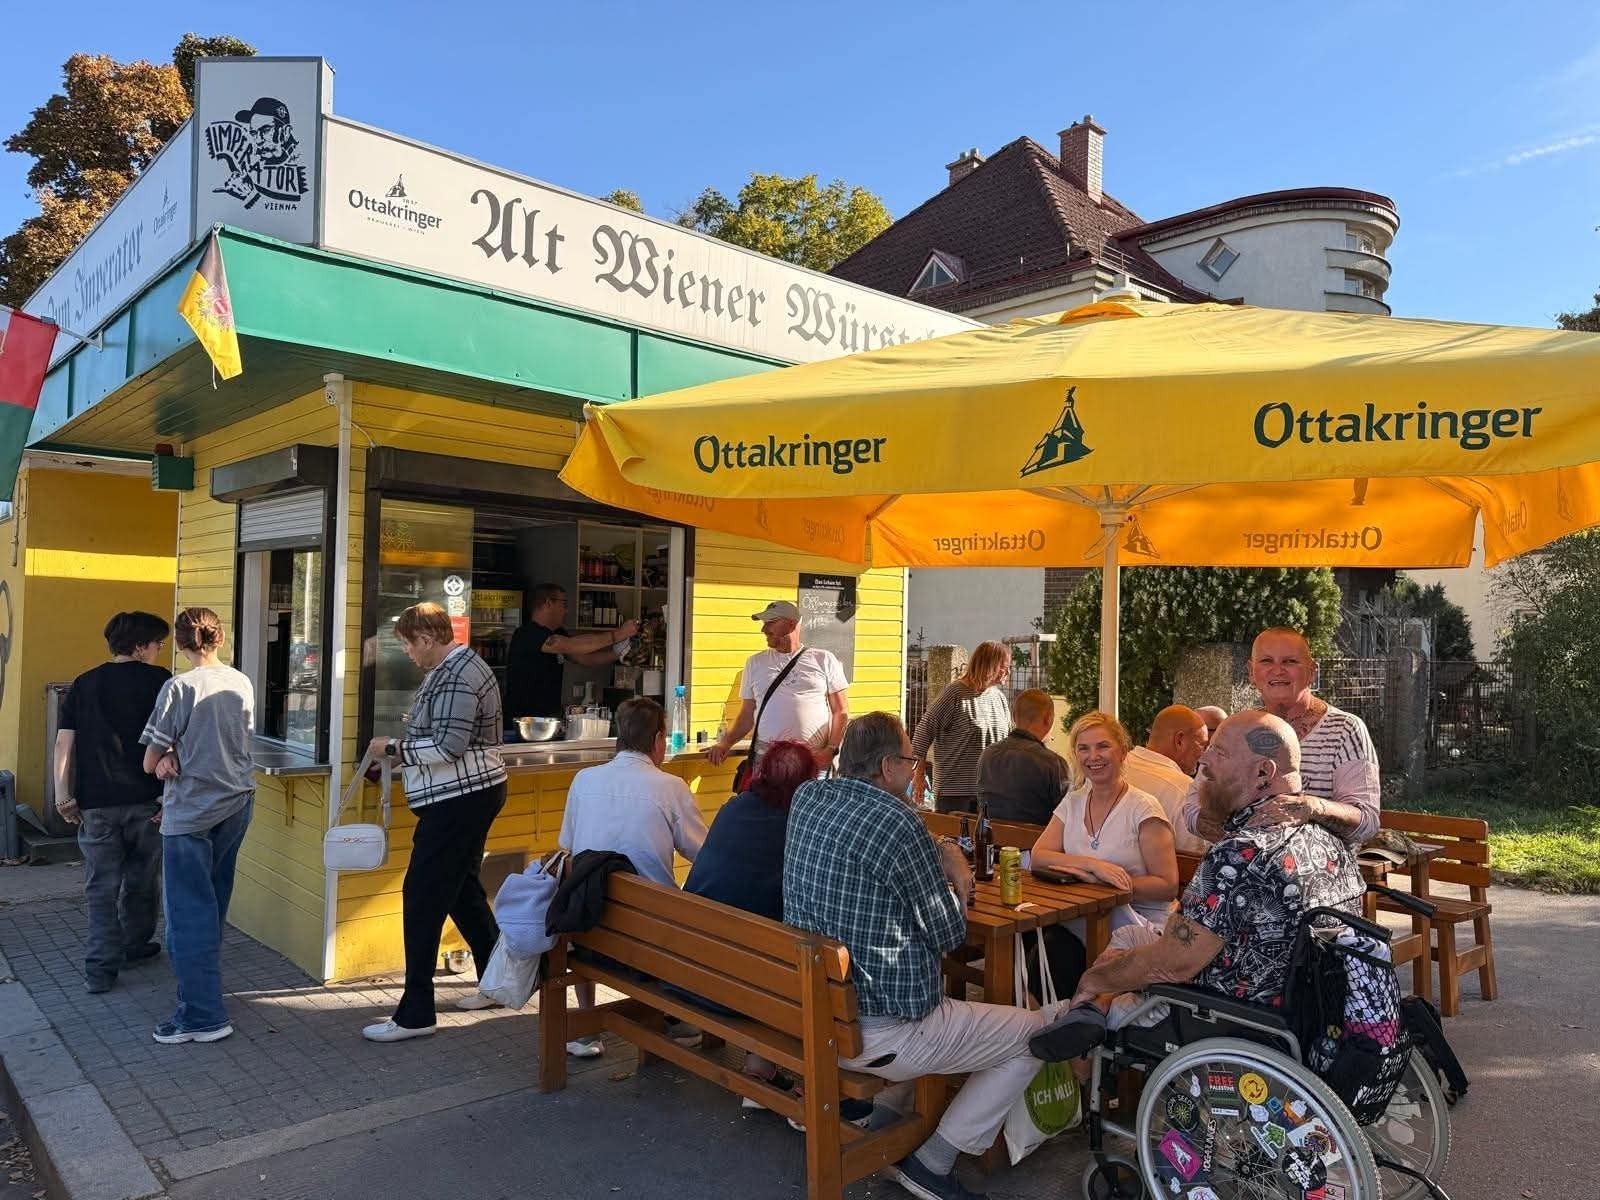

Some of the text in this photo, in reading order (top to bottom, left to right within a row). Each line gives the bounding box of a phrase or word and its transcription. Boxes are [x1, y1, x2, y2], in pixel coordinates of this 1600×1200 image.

[264, 202, 297, 210] VIENNA
[348, 189, 442, 230] Ottakringer
[471, 189, 565, 274] Alt
[592, 225, 766, 327] Wiener
[694, 401, 1542, 475] Ottakringer Ottakringer
[1208, 1075, 1234, 1087] FREE
[1033, 1089, 1052, 1106] ICH
